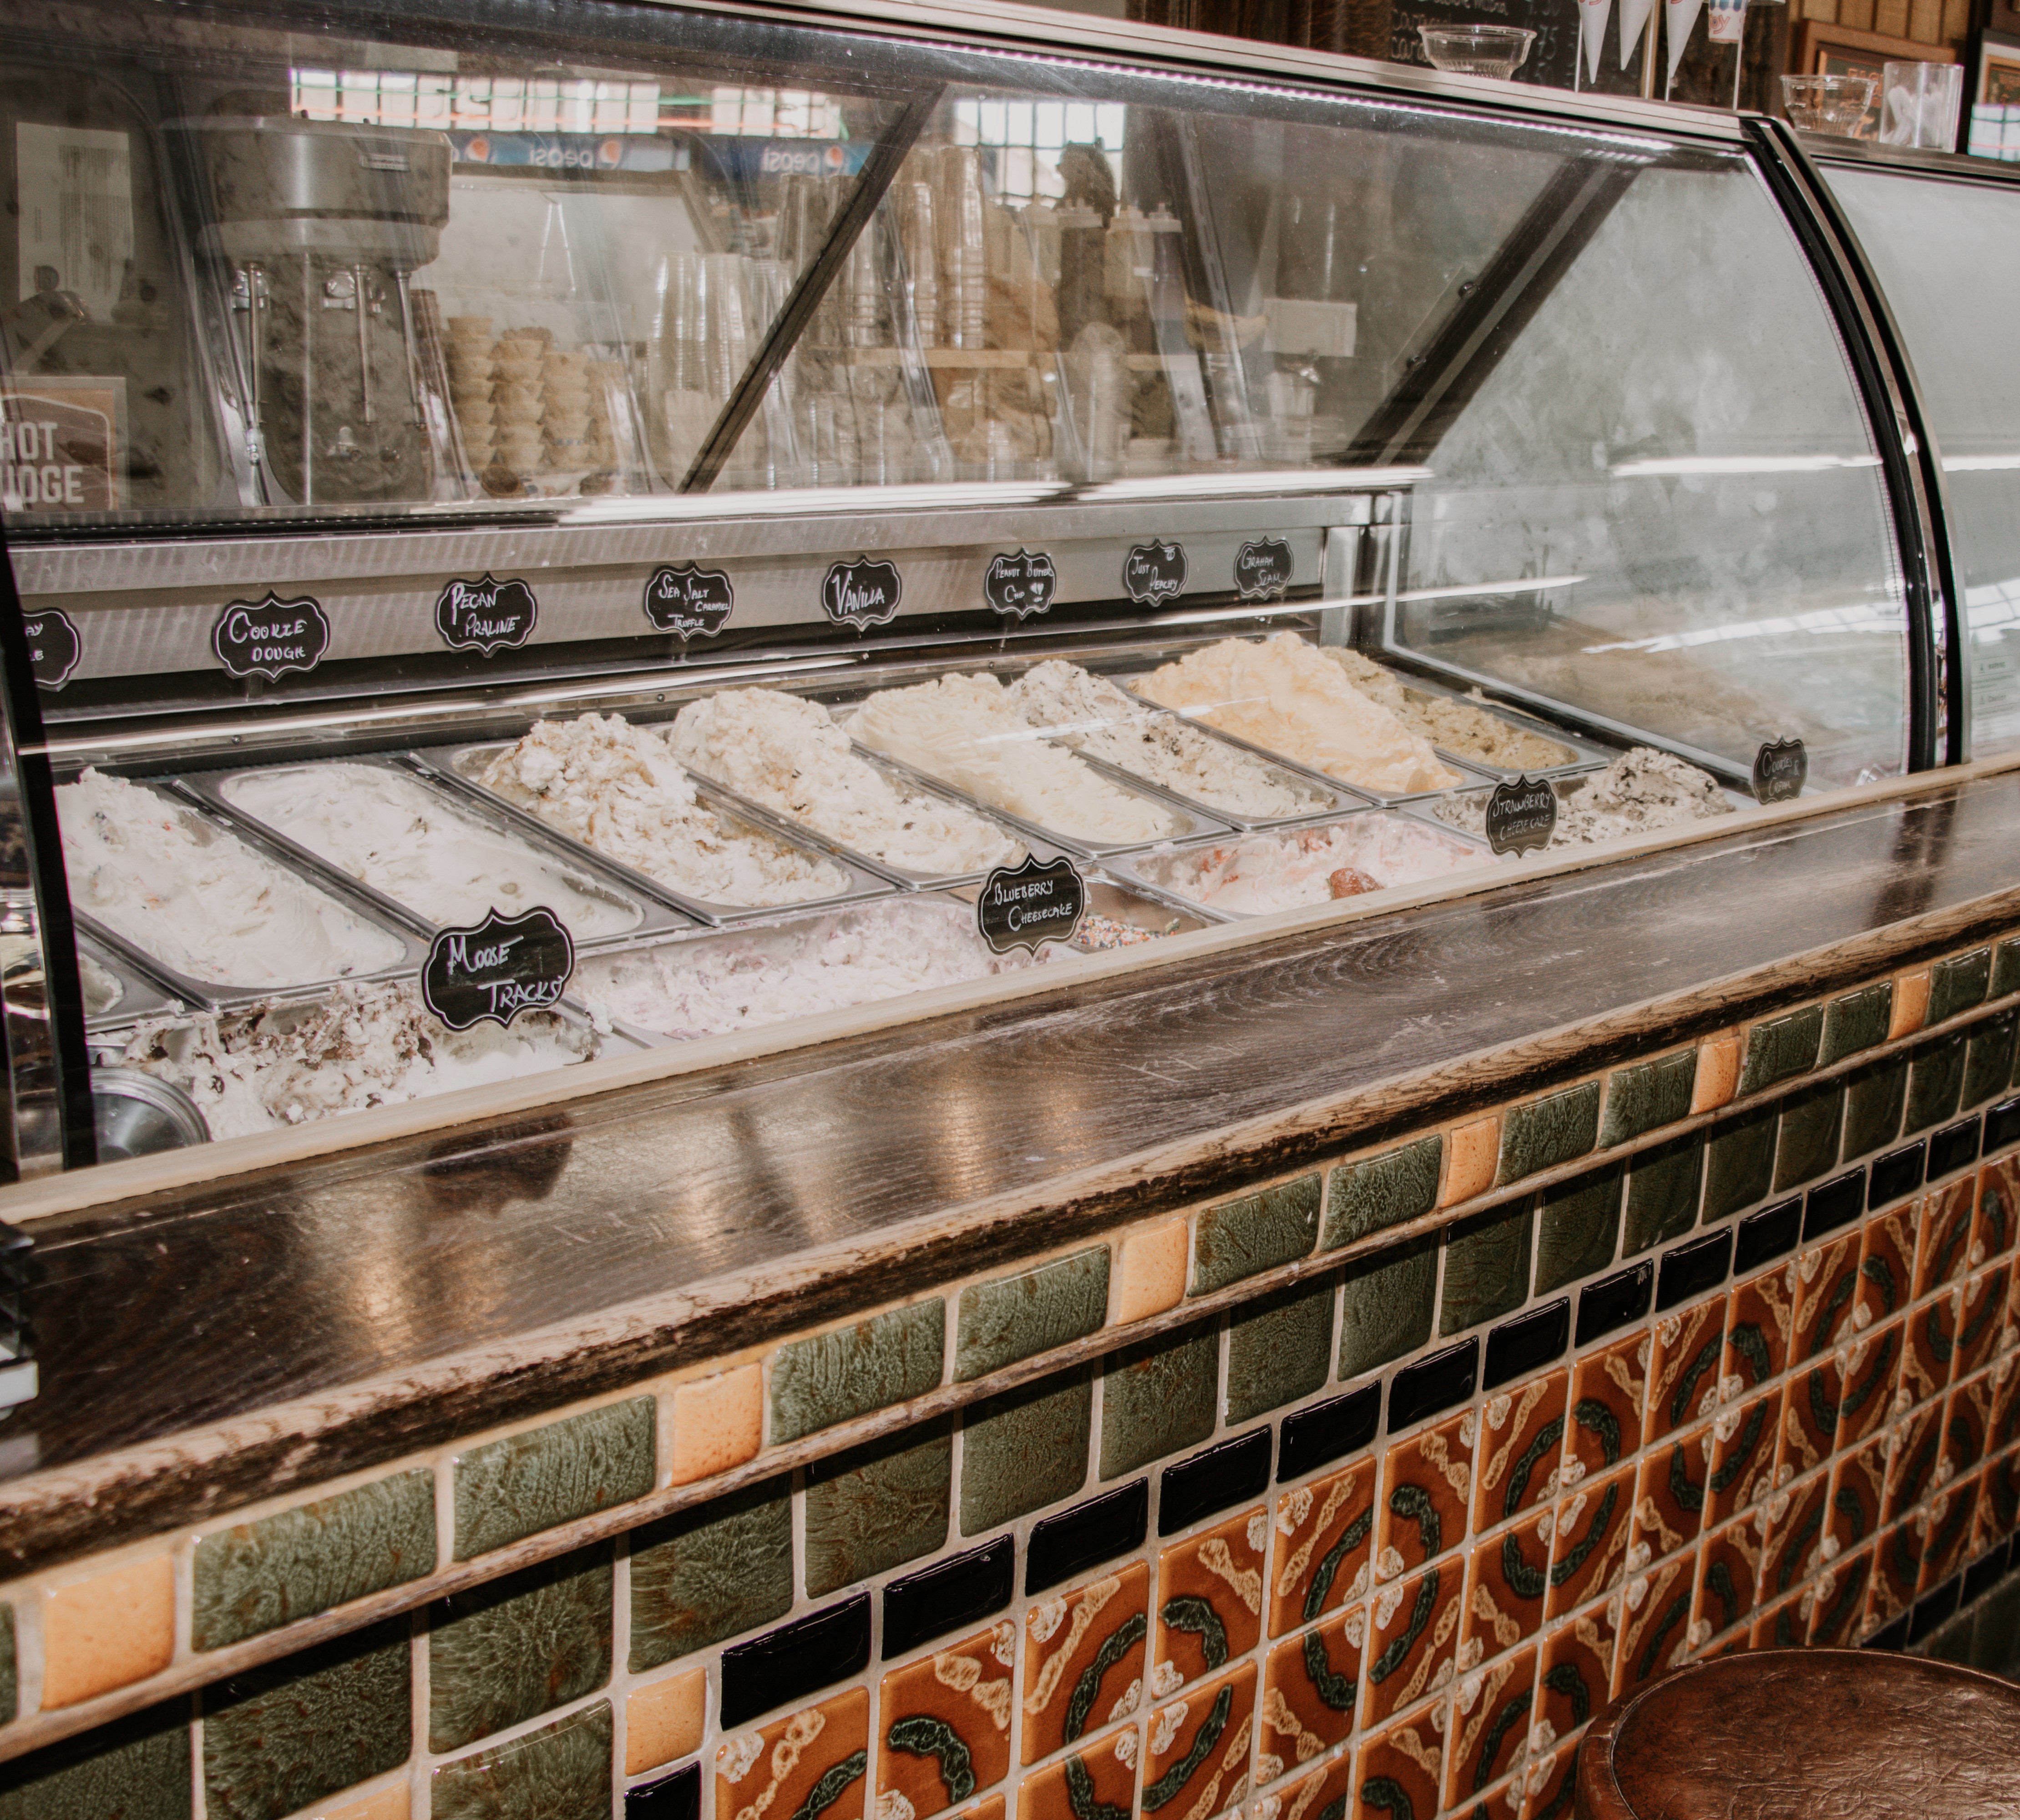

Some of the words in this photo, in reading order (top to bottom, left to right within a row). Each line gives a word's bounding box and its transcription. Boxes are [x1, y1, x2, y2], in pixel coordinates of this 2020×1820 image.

[1709, 14, 1731, 34] oy
[995, 558, 1021, 579] PEANUT
[1027, 560, 1054, 578] BUTTER
[1132, 556, 1150, 575] JUST
[658, 575, 681, 599] SEA
[683, 577, 709, 602] SALT
[1149, 566, 1178, 592] PEACHY
[451, 583, 506, 626] PECAN
[694, 601, 730, 612] CARAMEL
[1004, 586, 1025, 603] CHIP
[229, 612, 308, 643] COOKIE
[465, 614, 521, 637] PRALINE
[668, 614, 705, 628] TRUFFLE
[252, 646, 306, 662] DOUGH
[1493, 792, 1551, 818] STRAWBERRY
[995, 880, 1053, 906] BLUEBERRY
[1008, 903, 1073, 932] CHEESECAKE
[447, 935, 524, 975] MOOSE
[477, 976, 563, 1012] TRACKS
